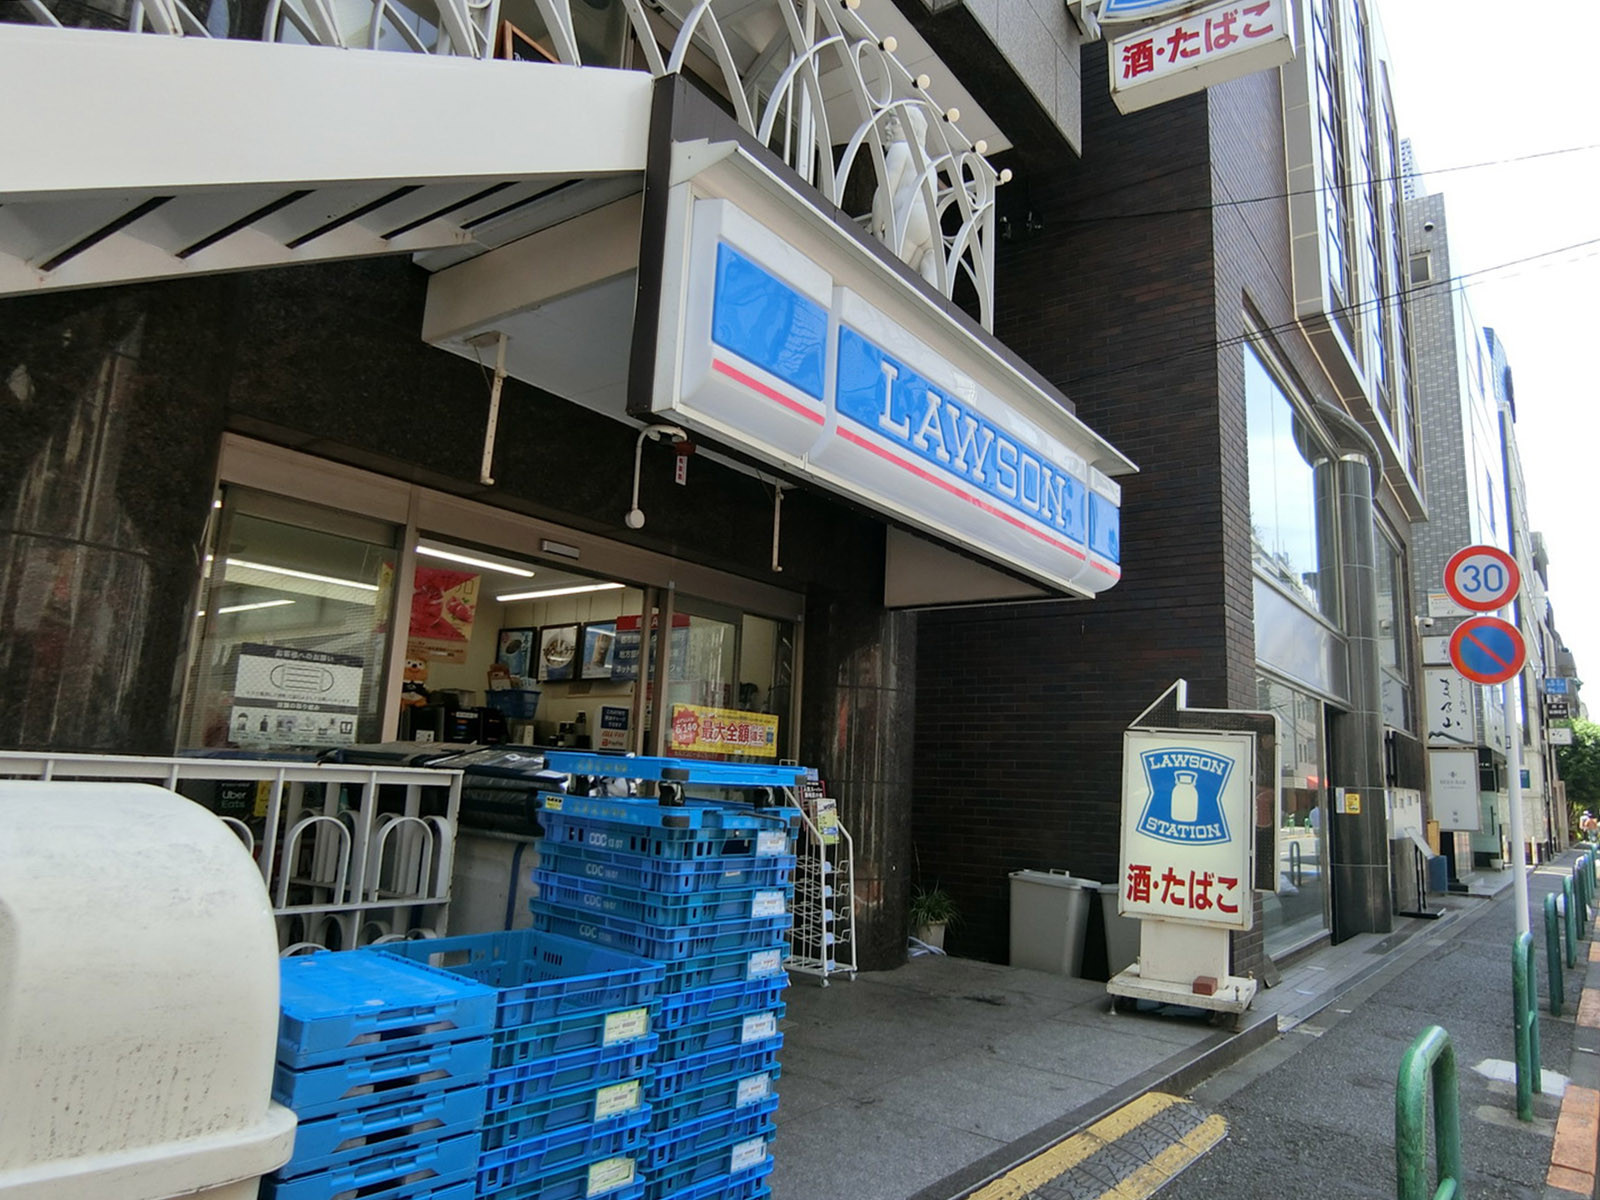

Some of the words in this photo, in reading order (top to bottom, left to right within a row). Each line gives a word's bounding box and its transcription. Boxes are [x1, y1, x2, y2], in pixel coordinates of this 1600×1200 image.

[1122, 1, 1274, 79] 酒・たばこ
[879, 361, 1066, 527] LAWSON
[1462, 563, 1504, 593] 30
[1149, 754, 1225, 776] LAWSON
[222, 790, 247, 800] Uber
[221, 800, 246, 809] Eats
[1146, 817, 1222, 839] STATION
[589, 832, 607, 847] CDC
[586, 863, 604, 877] CDC
[1126, 863, 1239, 914] 酒・たばこ
[584, 894, 602, 908] CDC
[580, 924, 598, 939] CDC
